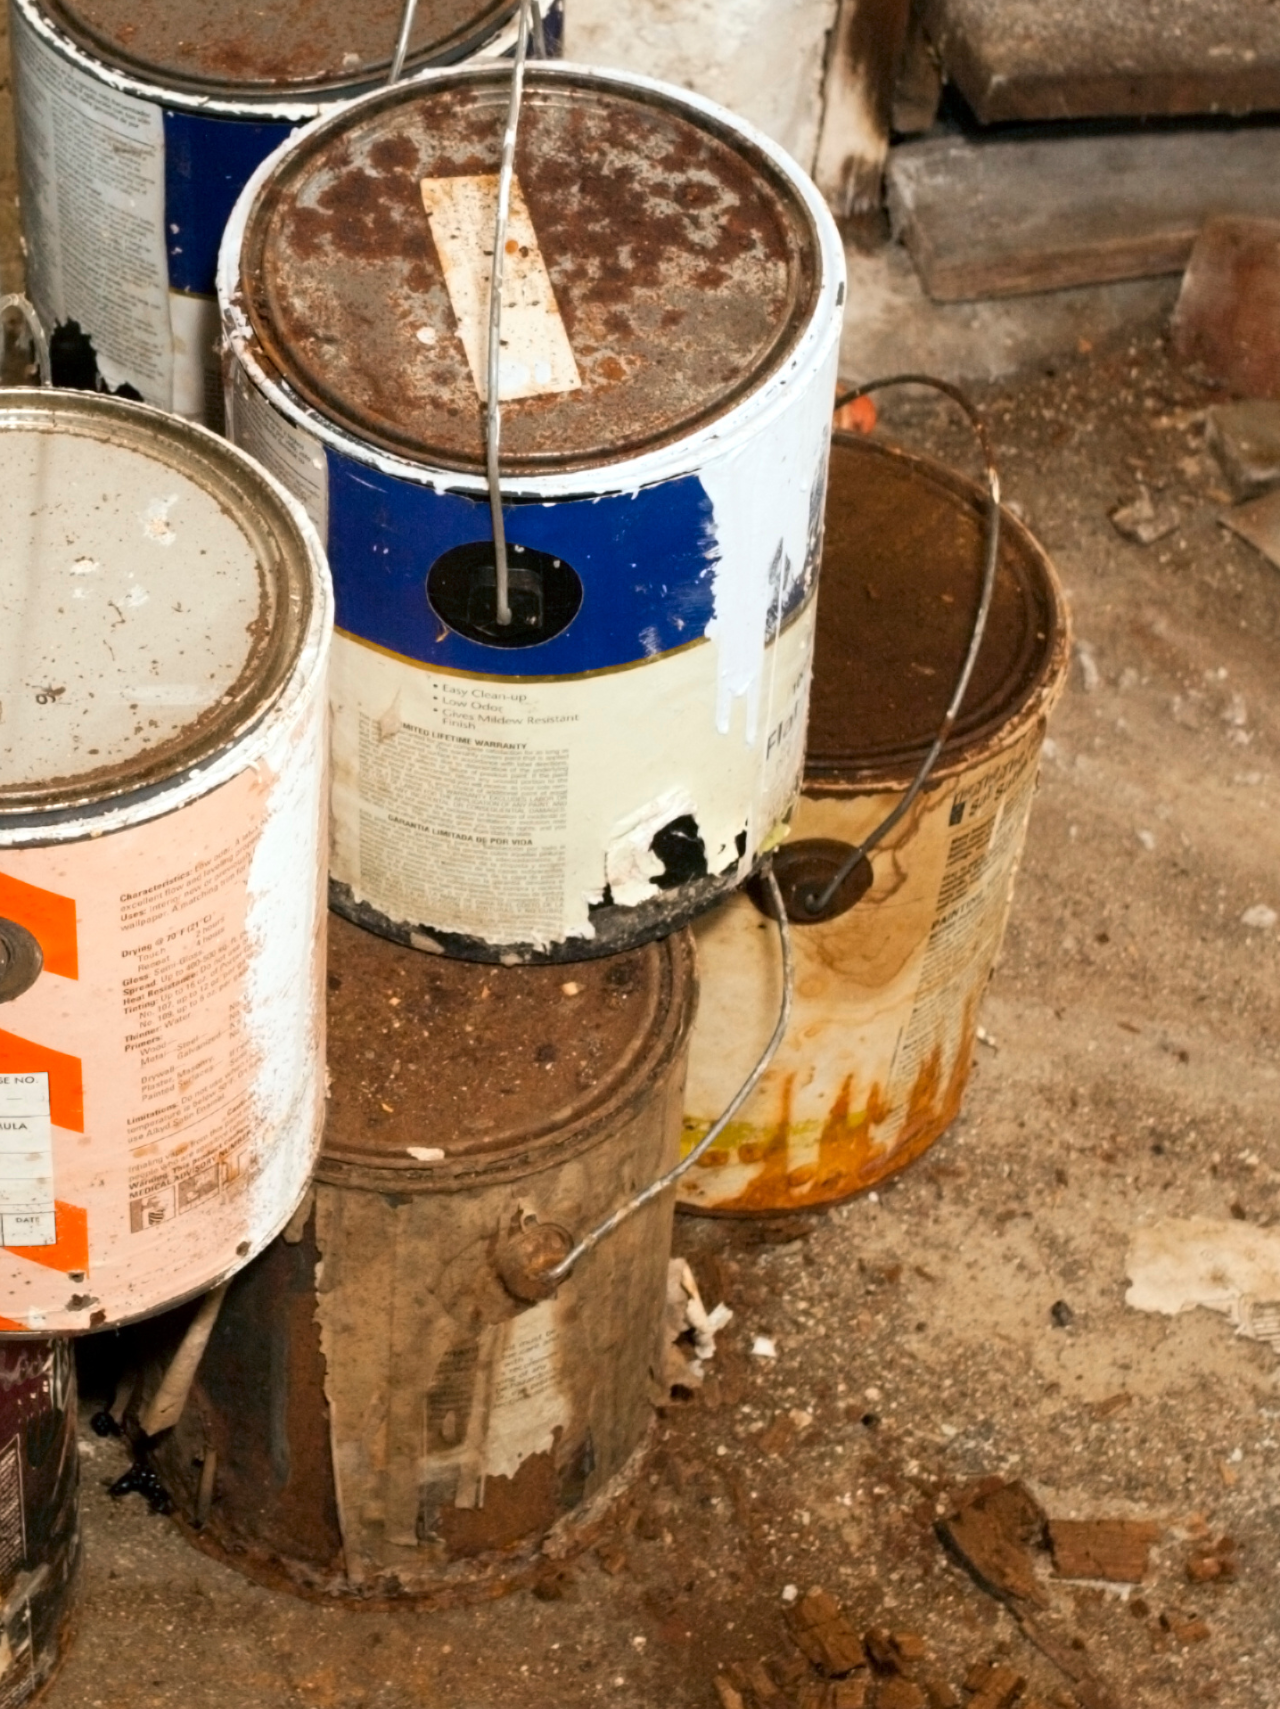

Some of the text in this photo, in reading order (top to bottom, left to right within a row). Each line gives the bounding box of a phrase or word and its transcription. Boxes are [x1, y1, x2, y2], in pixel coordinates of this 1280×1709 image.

[442, 684, 527, 703] Easy Clean-up
[442, 696, 502, 712] Low Odor
[442, 708, 579, 725] Gives Mildew Resistant
[442, 718, 476, 730] Finish
[432, 731, 527, 750] LIFETIME WARRANTY
[432, 828, 473, 842] LIMITADA
[120, 871, 192, 902] Characteristics:
[121, 876, 201, 912] excellent flow and
[120, 910, 169, 931] wallpaper.
[180, 884, 218, 910] matching
[121, 909, 147, 922] Uses:
[184, 886, 202, 897] new
[138, 915, 225, 962] Touch hours
[203, 926, 225, 943] hours
[122, 943, 152, 958] Drying
[160, 973, 174, 984] Up
[176, 965, 184, 973] to
[123, 963, 212, 1006] Heat Resistance: Do
[160, 991, 173, 1002] Up
[176, 984, 208, 1008] up 12
[176, 1006, 188, 1016] up
[125, 1013, 192, 1042] Thinner: Water
[14, 1076, 38, 1084] NO.
[142, 1084, 175, 1102] Painted
[181, 1094, 192, 1105] Do
[194, 1086, 208, 1098] not
[210, 1077, 224, 1092] use
[127, 1091, 216, 1134] temperature below
[128, 1112, 194, 1144] use Alkyd Satin
[128, 1156, 164, 1174] Inhaling
[128, 1166, 159, 1182] people
[172, 1162, 190, 1174] This
[129, 1178, 172, 1199] MEDICAL
[174, 1156, 216, 1182] ADVISORY
